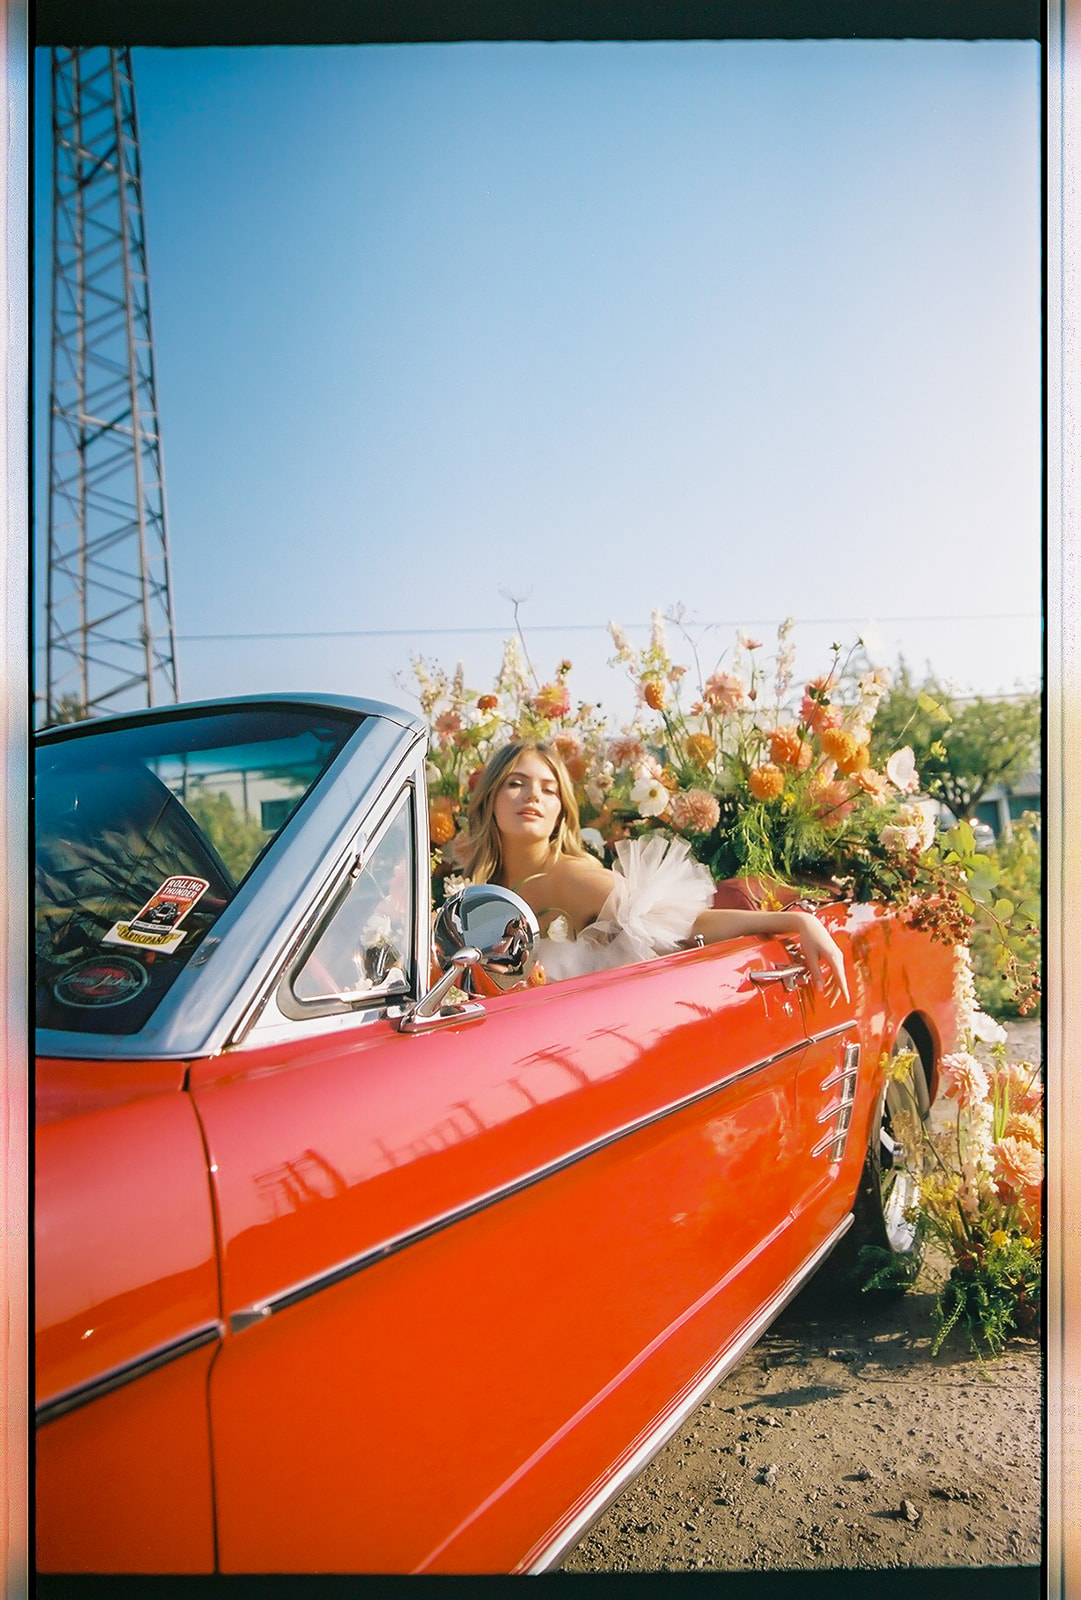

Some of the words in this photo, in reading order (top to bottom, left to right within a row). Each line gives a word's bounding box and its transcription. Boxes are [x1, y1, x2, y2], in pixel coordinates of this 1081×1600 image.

[167, 879, 203, 892] ROLLING
[162, 887, 198, 898] THUNDER
[119, 928, 168, 945] PARTICIPANT
